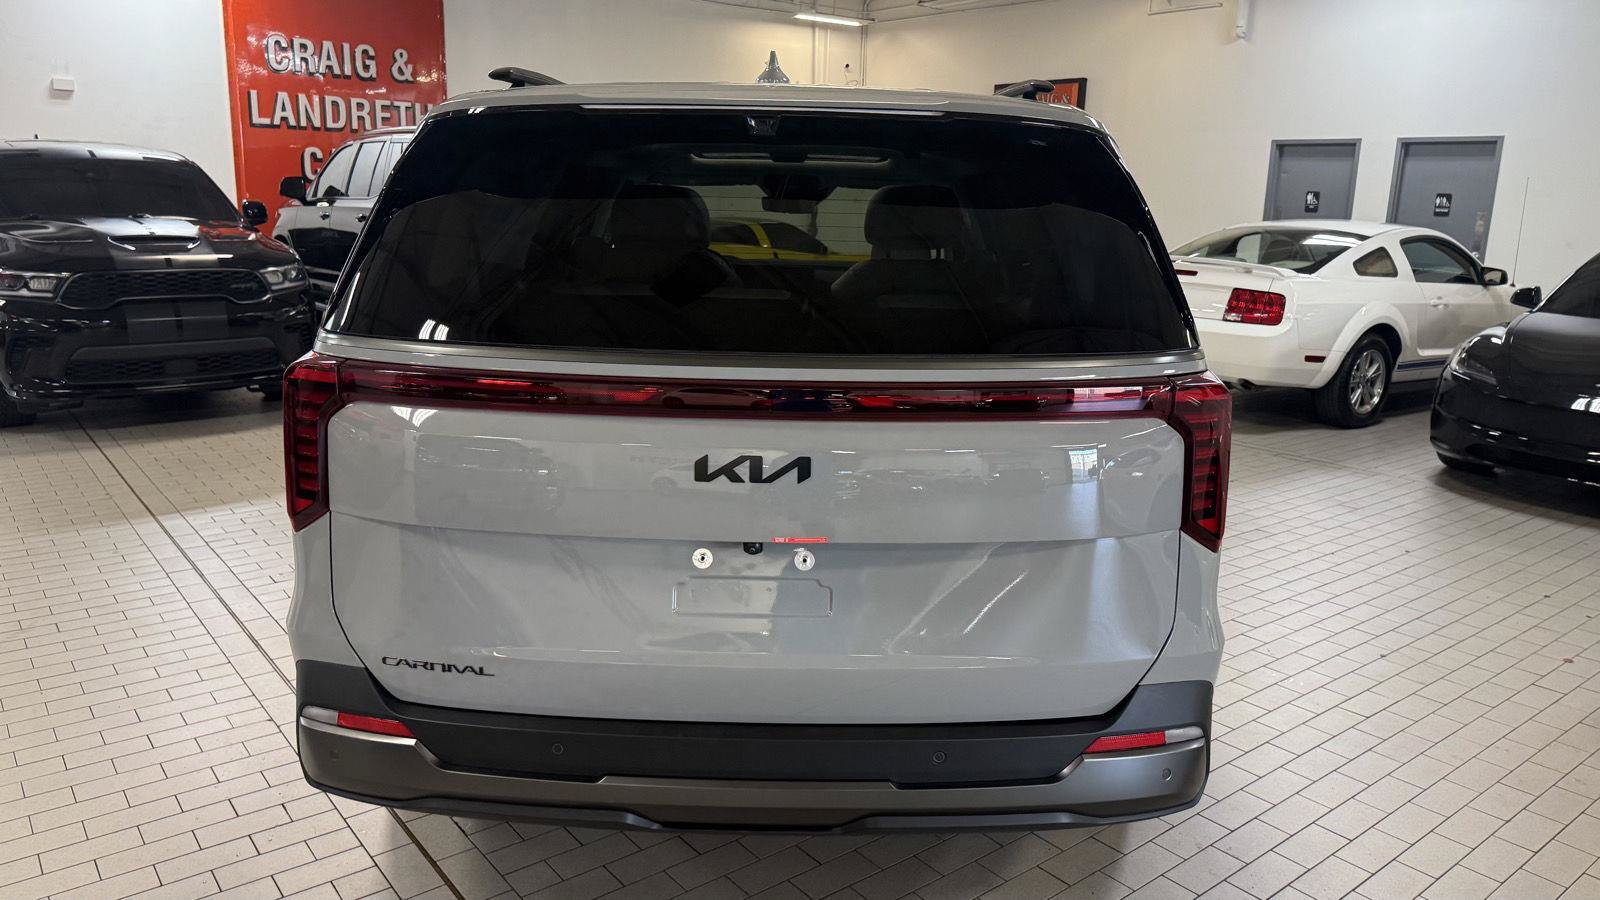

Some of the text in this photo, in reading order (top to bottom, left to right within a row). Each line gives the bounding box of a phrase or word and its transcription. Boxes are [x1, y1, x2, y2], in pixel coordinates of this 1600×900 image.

[265, 34, 415, 83] CRAIG &
[694, 454, 812, 484] KIA
[381, 656, 495, 677] CARNIVAL
